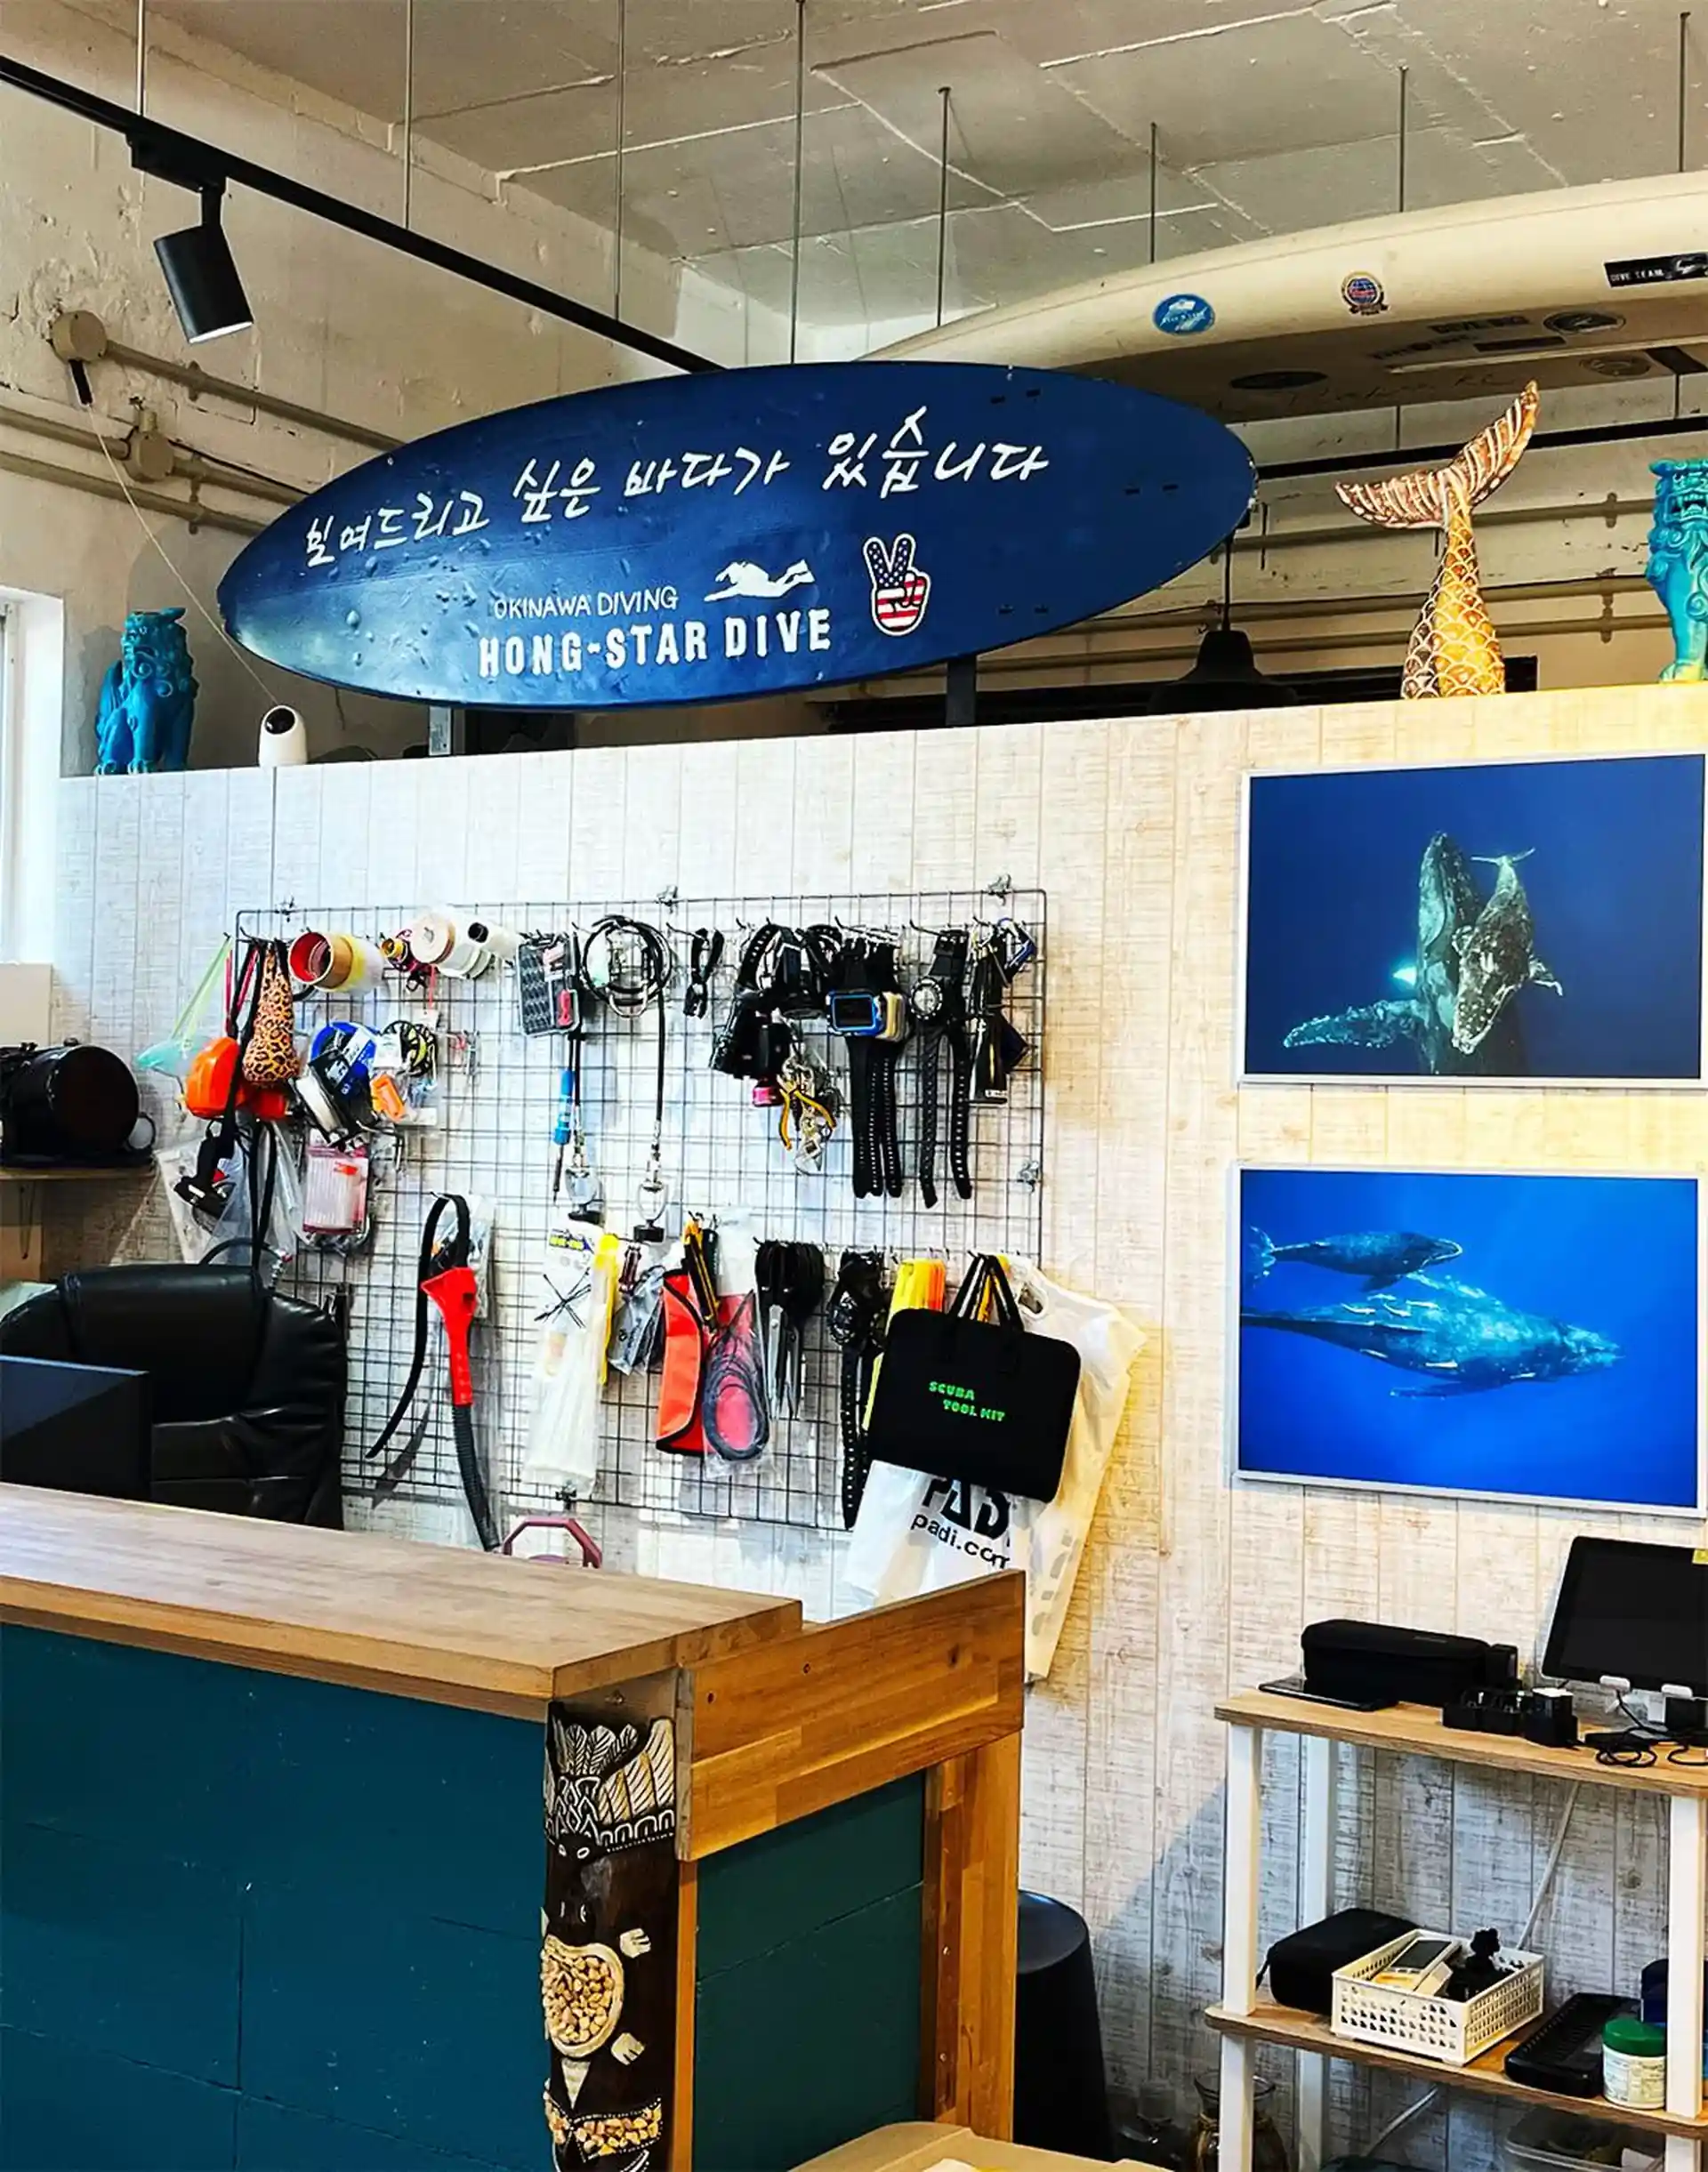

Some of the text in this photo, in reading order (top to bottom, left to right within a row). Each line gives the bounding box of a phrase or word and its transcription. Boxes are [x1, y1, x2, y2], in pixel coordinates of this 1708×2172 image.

[512, 457, 601, 523] 싶은
[624, 446, 791, 497] 바다가
[822, 405, 1050, 500] 있습니다
[493, 585, 680, 620] OKINAWA DIVING
[478, 607, 832, 679] HONG-STAR DIVE
[928, 1380, 975, 1402] SCUBA
[943, 1399, 1005, 1422] TOOL KIT
